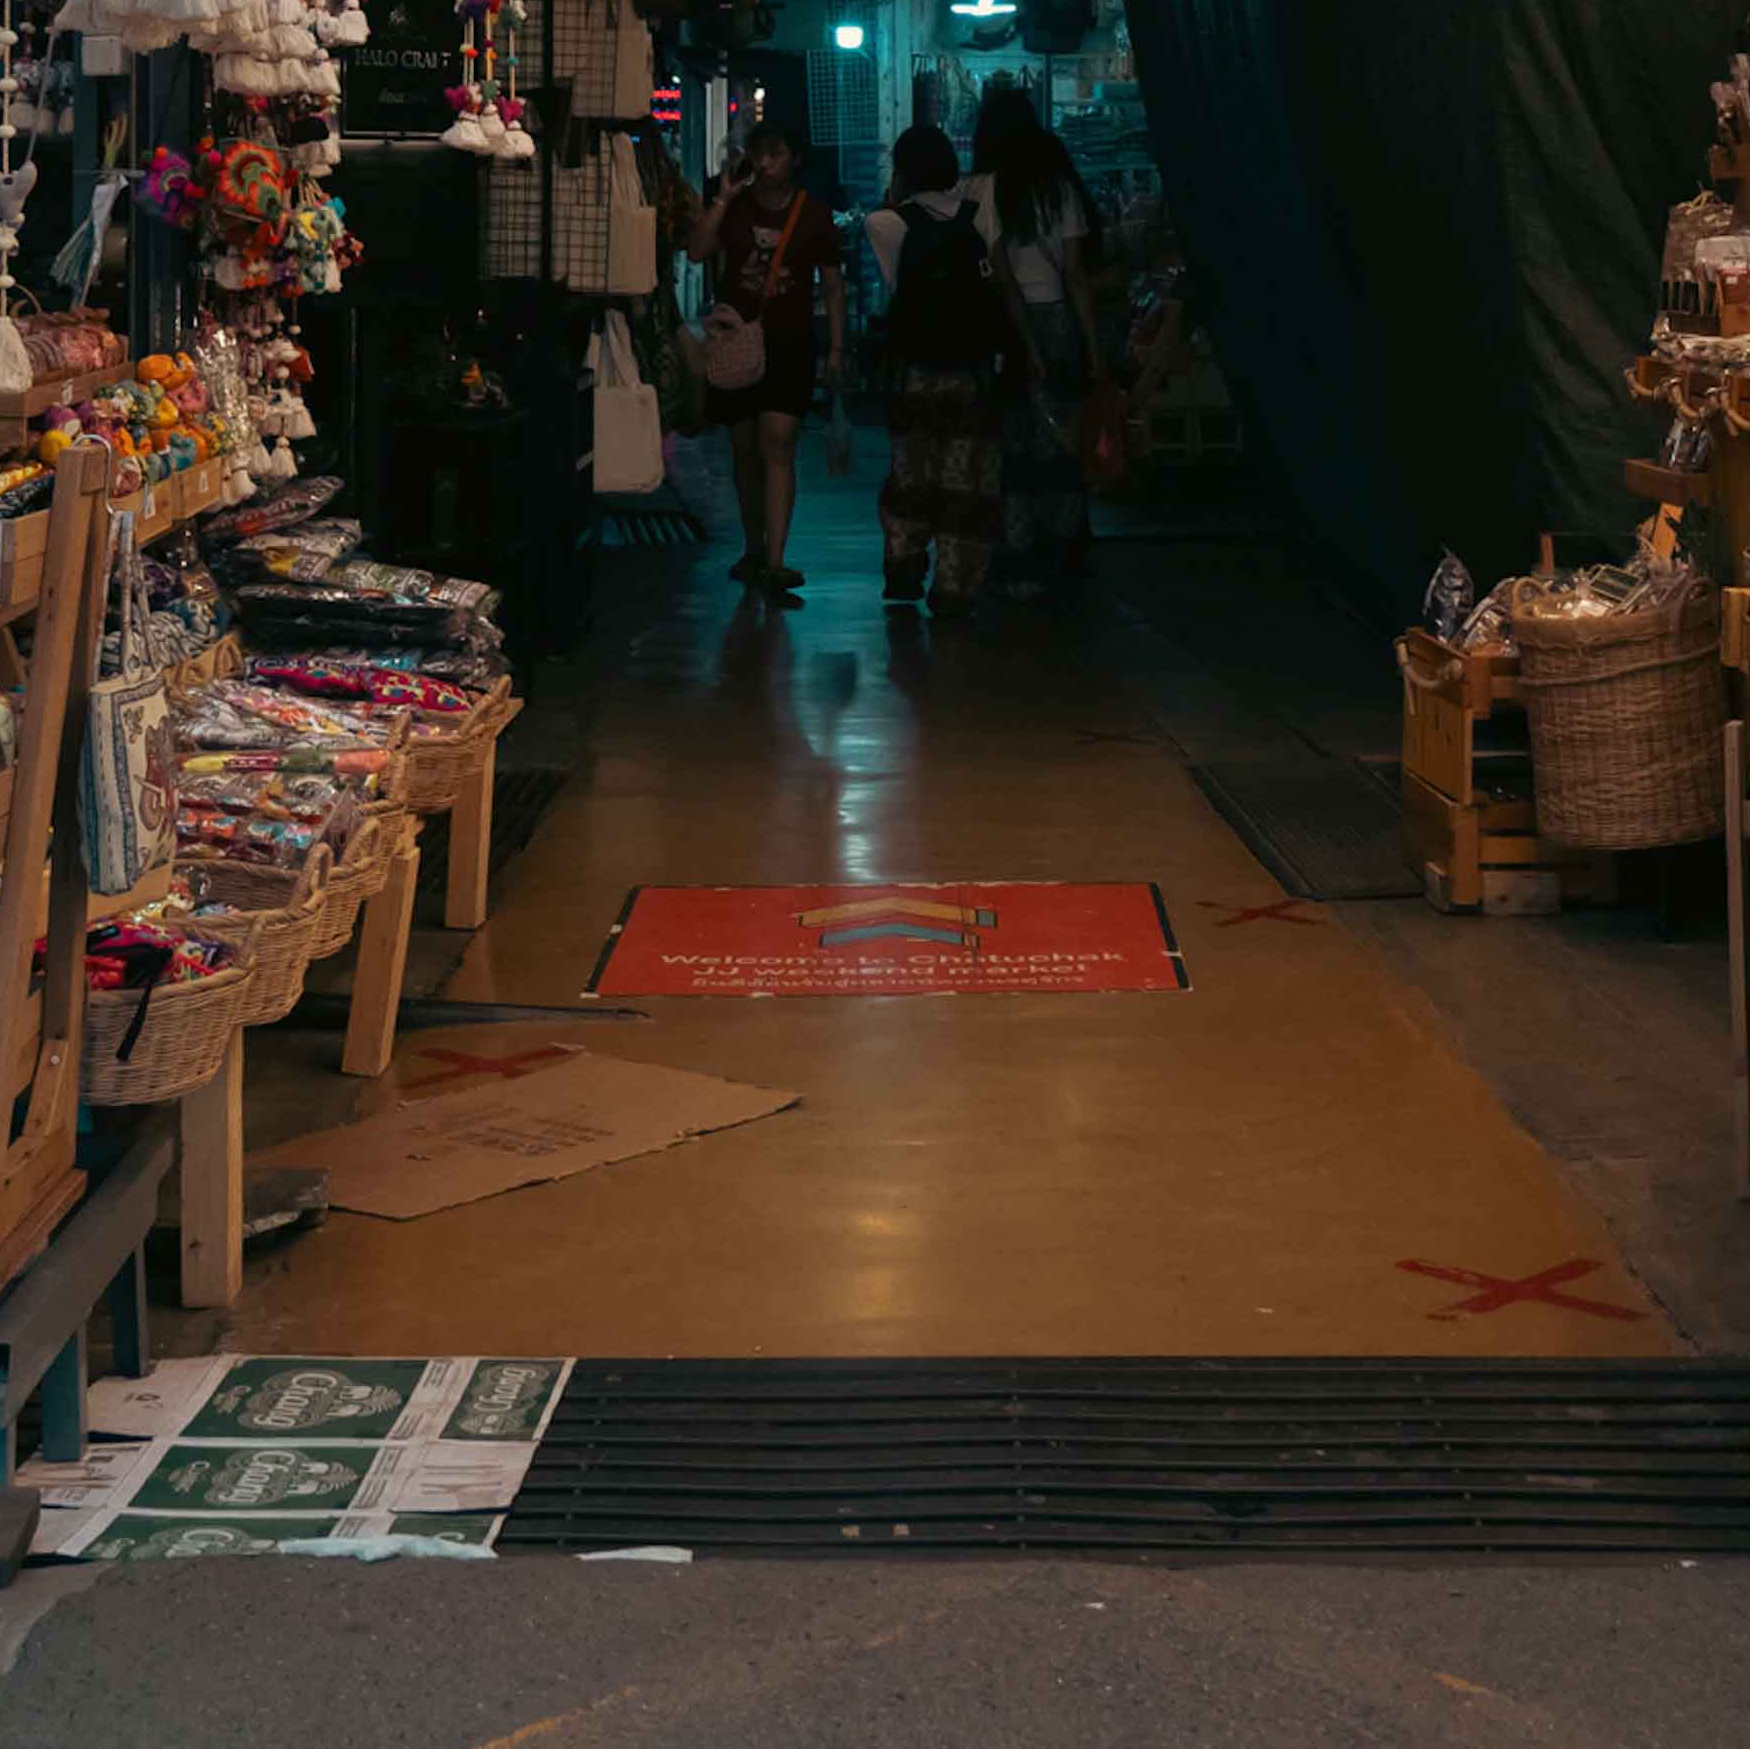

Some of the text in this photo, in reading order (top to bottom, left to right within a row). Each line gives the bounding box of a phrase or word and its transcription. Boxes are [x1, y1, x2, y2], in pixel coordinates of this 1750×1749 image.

[660, 949, 1127, 966] Welcome to Chatuchak
[752, 964, 938, 977] weekend
[946, 961, 1089, 976] market
[251, 1368, 340, 1431] Chang
